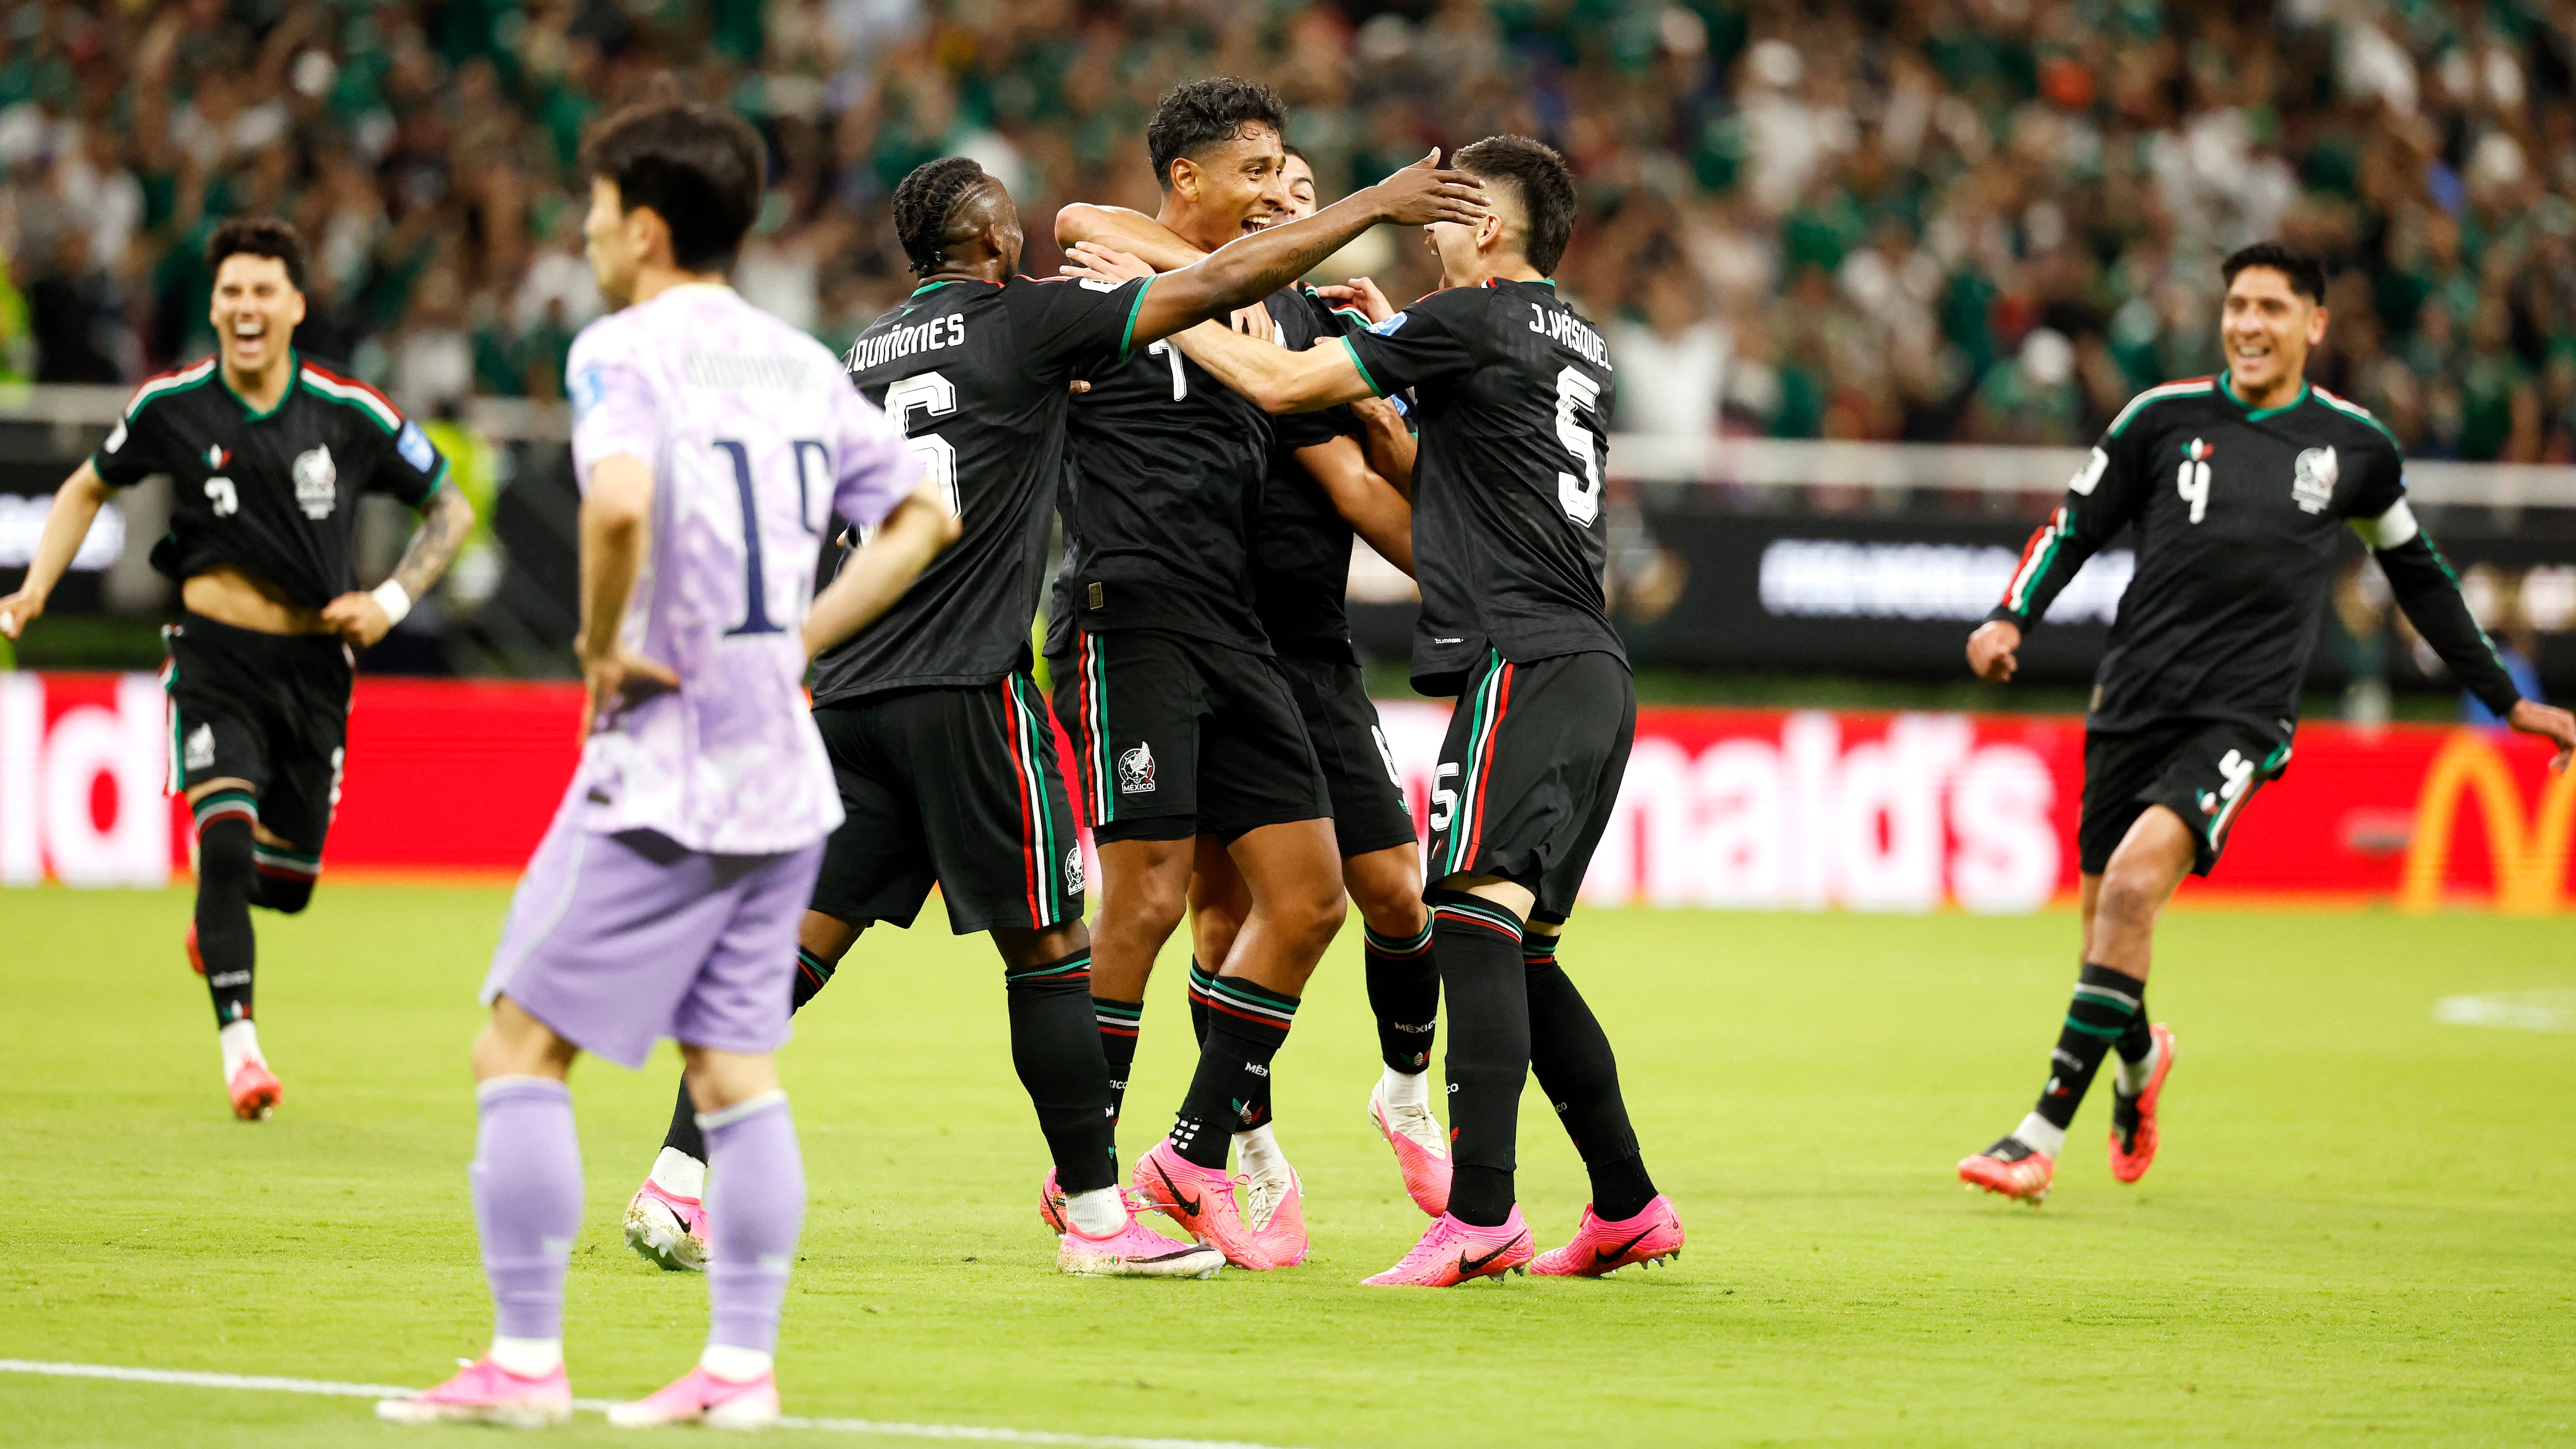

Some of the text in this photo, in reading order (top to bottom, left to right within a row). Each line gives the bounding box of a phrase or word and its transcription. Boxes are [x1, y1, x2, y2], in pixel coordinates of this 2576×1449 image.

[1148, 337, 1187, 401] 7
[867, 371, 961, 538] 6
[1555, 365, 1600, 528] 5
[2177, 460, 2211, 524] 4
[1124, 782, 1153, 792] MÉXICO
[1430, 762, 1459, 832] 5
[2218, 748, 2254, 800] 4
